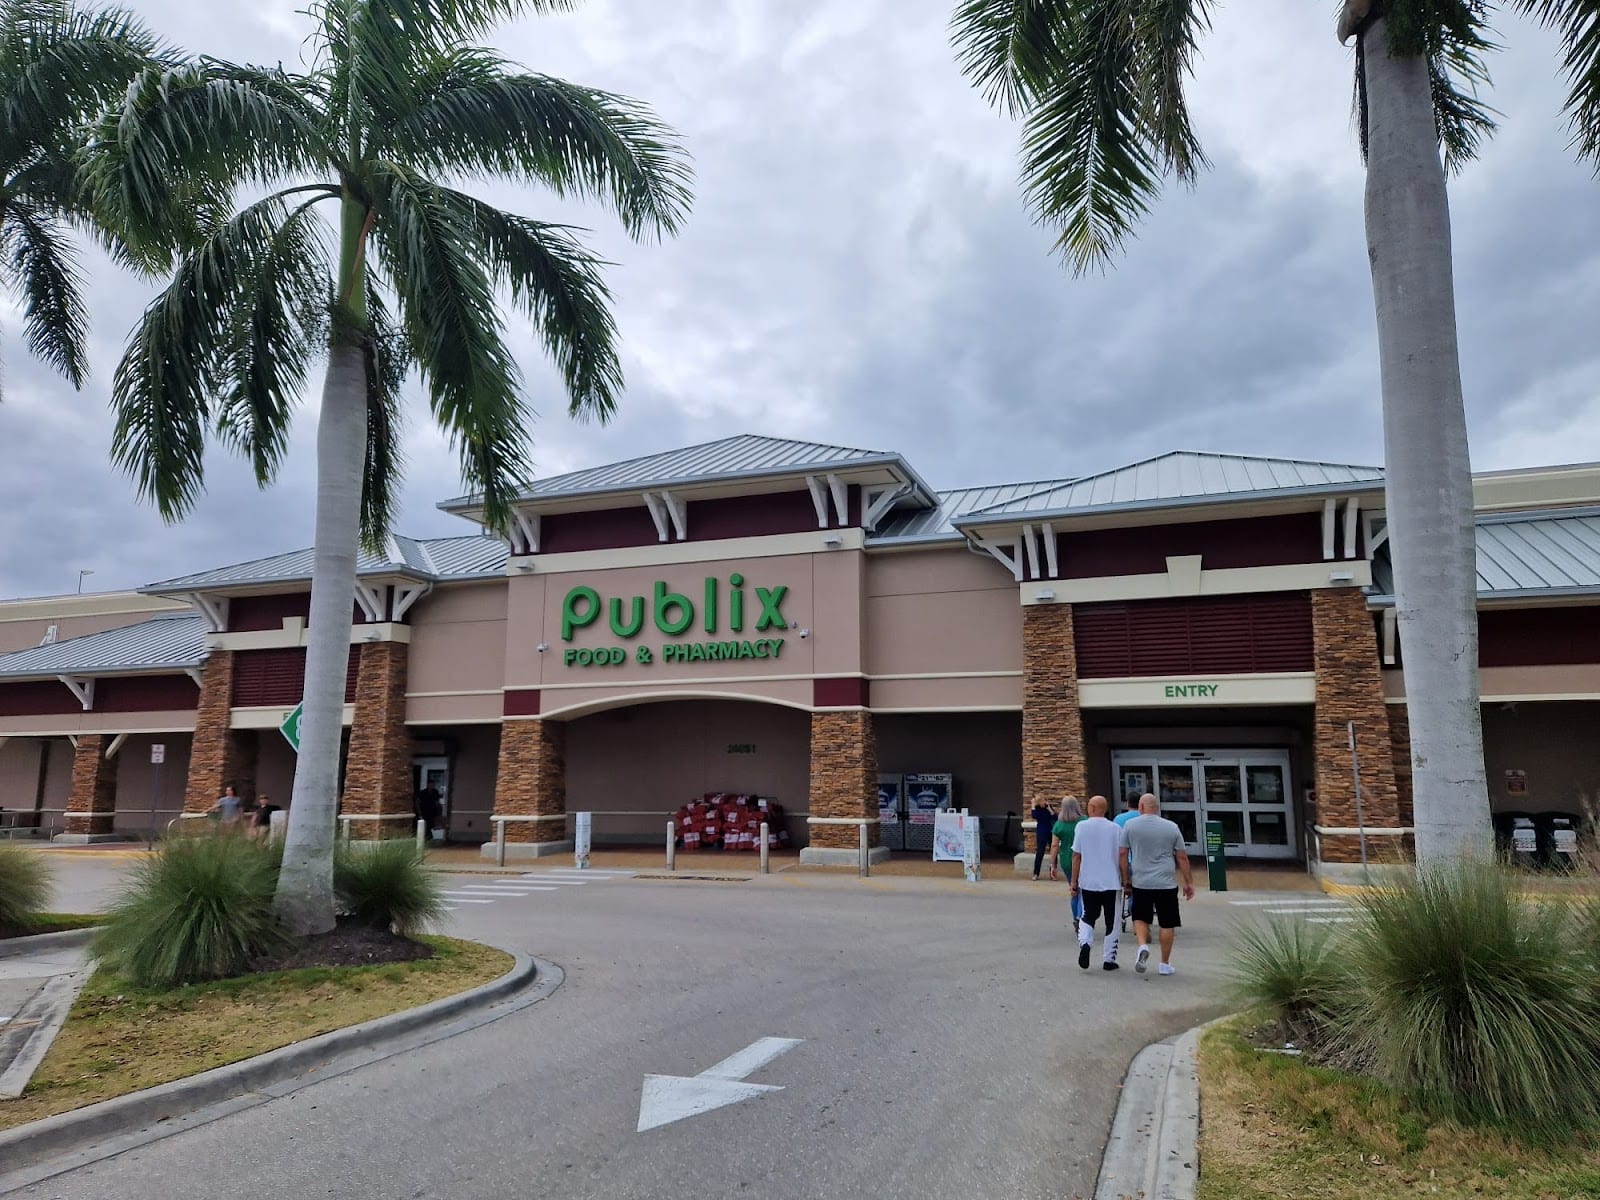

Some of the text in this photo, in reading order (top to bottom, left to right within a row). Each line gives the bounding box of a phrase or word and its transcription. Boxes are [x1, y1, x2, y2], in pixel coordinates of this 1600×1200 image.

[561, 573, 788, 641] Publix
[564, 638, 785, 667] FOOD & PHARMACY
[1165, 684, 1218, 698] ENTRY
